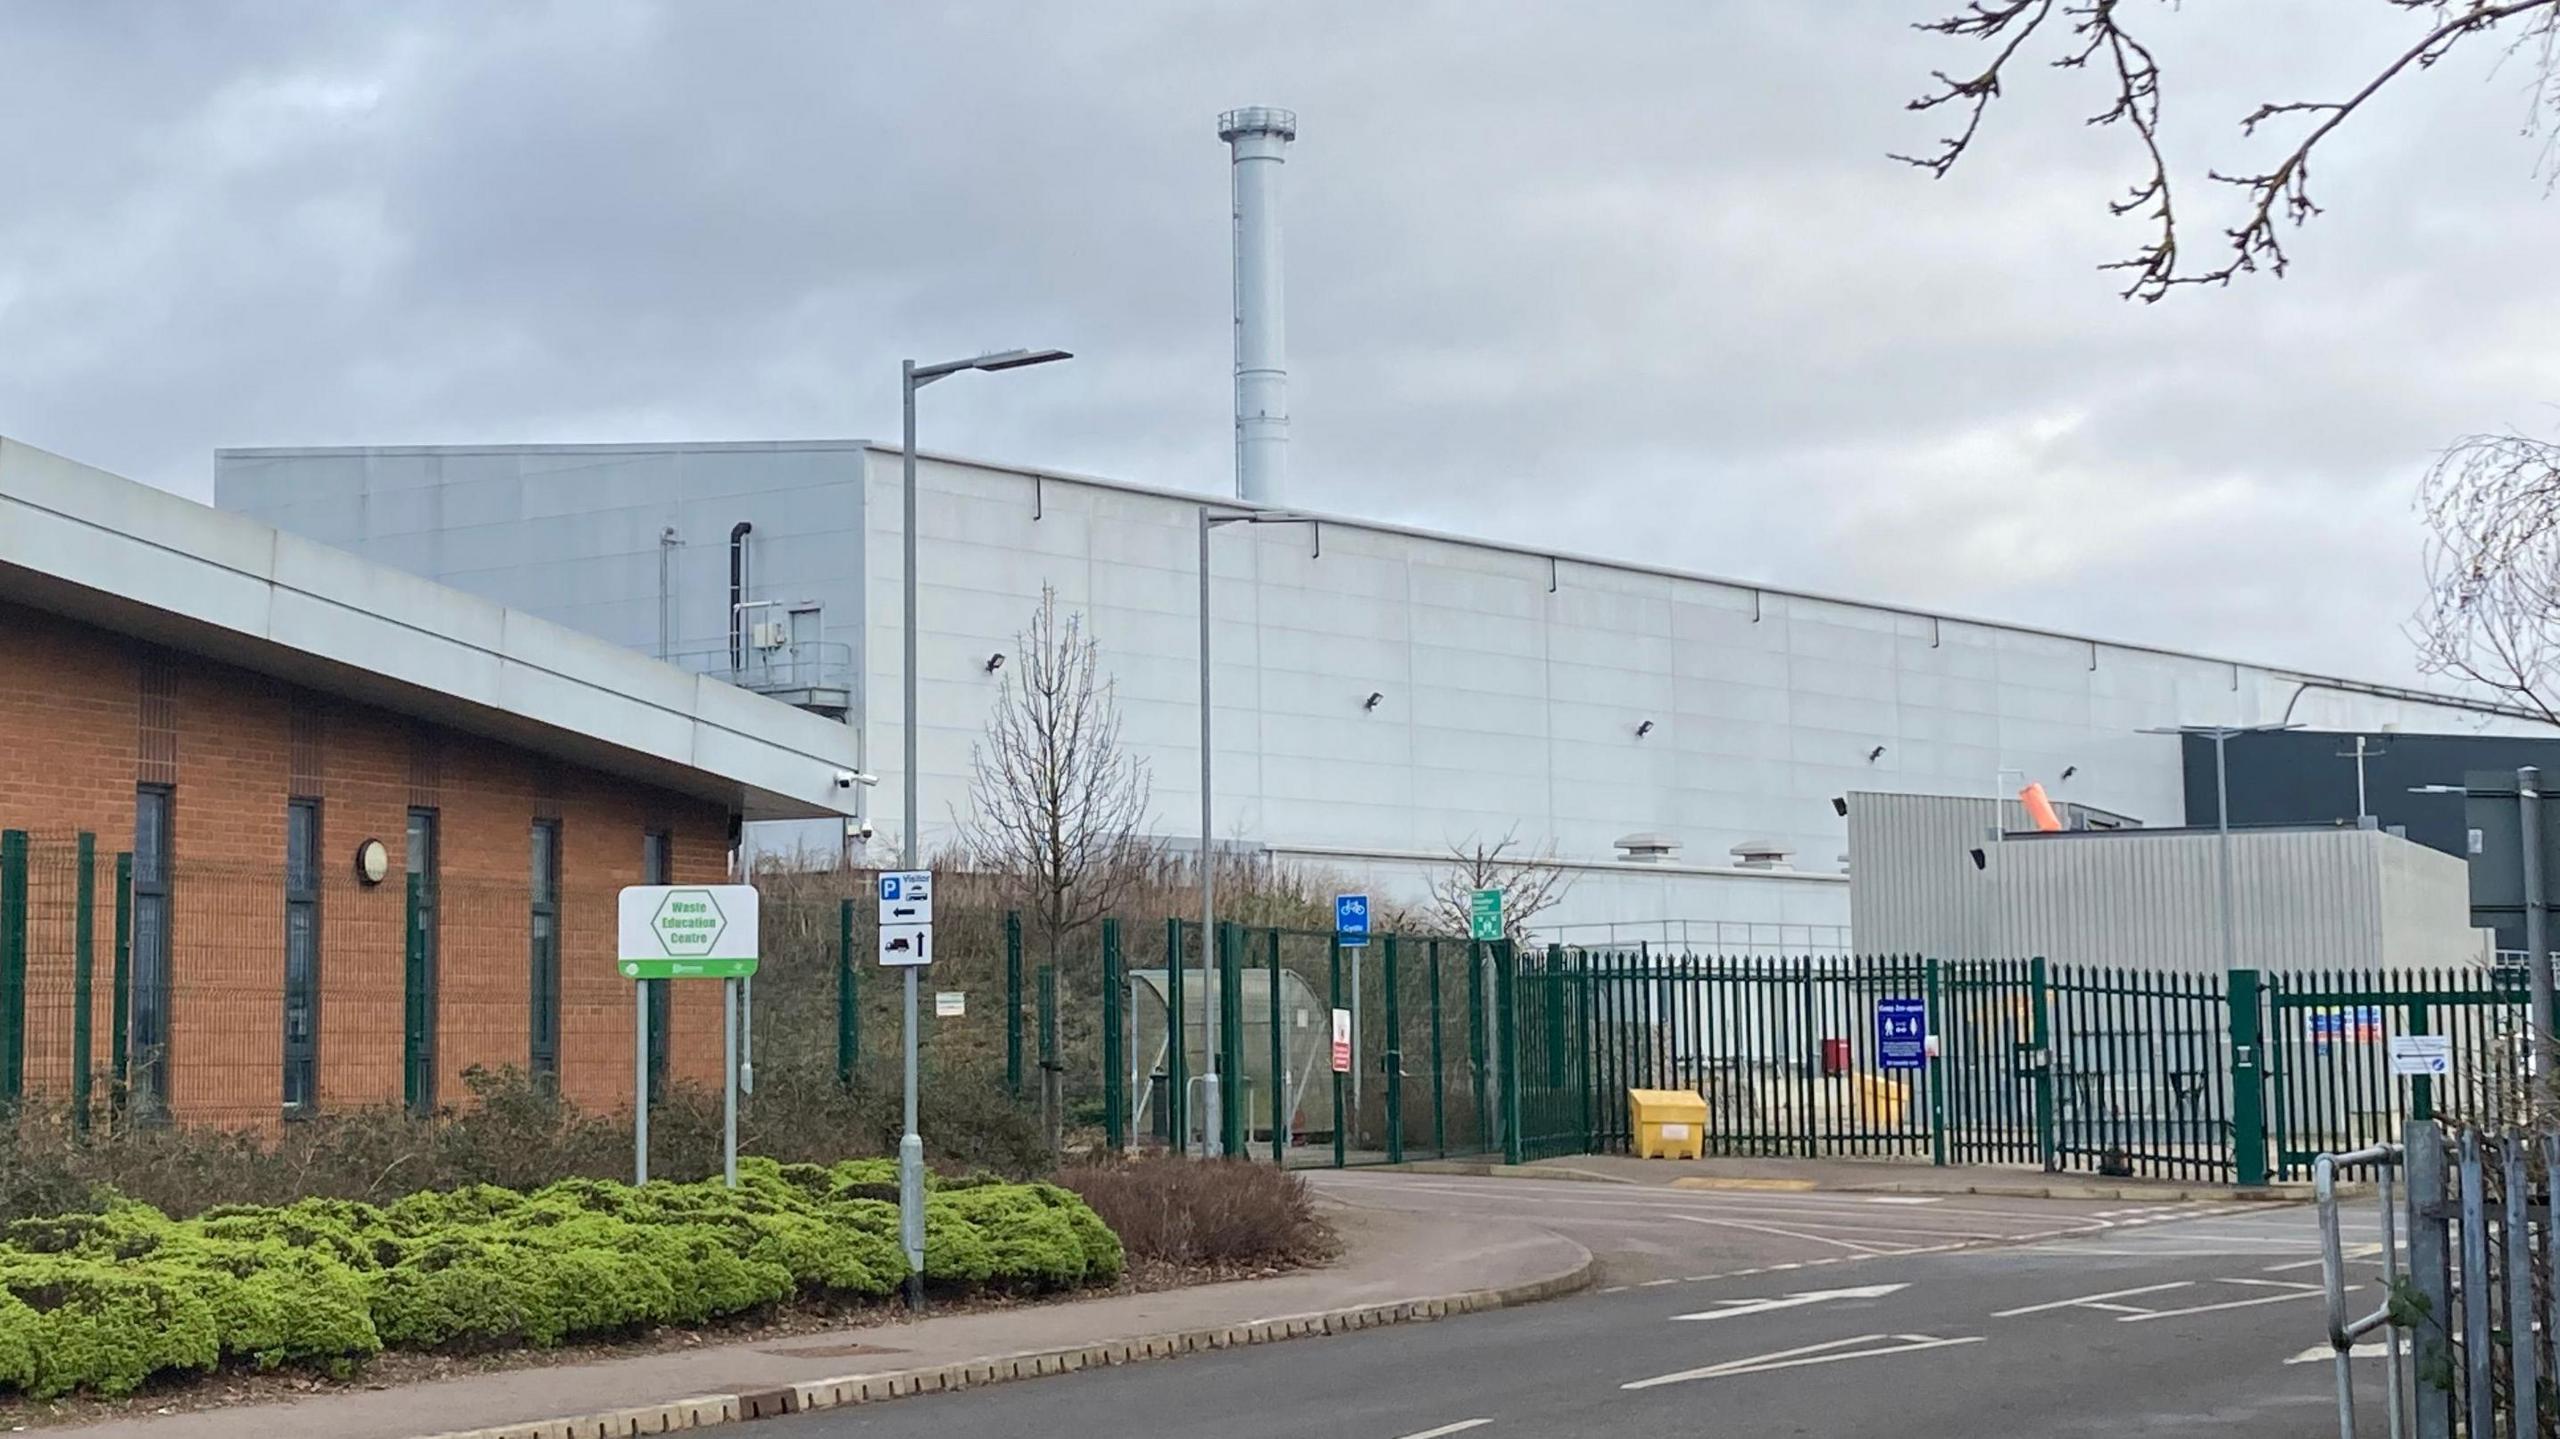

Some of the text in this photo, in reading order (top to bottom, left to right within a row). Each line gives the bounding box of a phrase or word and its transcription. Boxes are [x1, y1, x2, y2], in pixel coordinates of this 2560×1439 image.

[884, 880, 896, 898] P
[671, 902, 707, 913] Waste
[662, 917, 716, 929] Education
[670, 932, 708, 944] Centre
